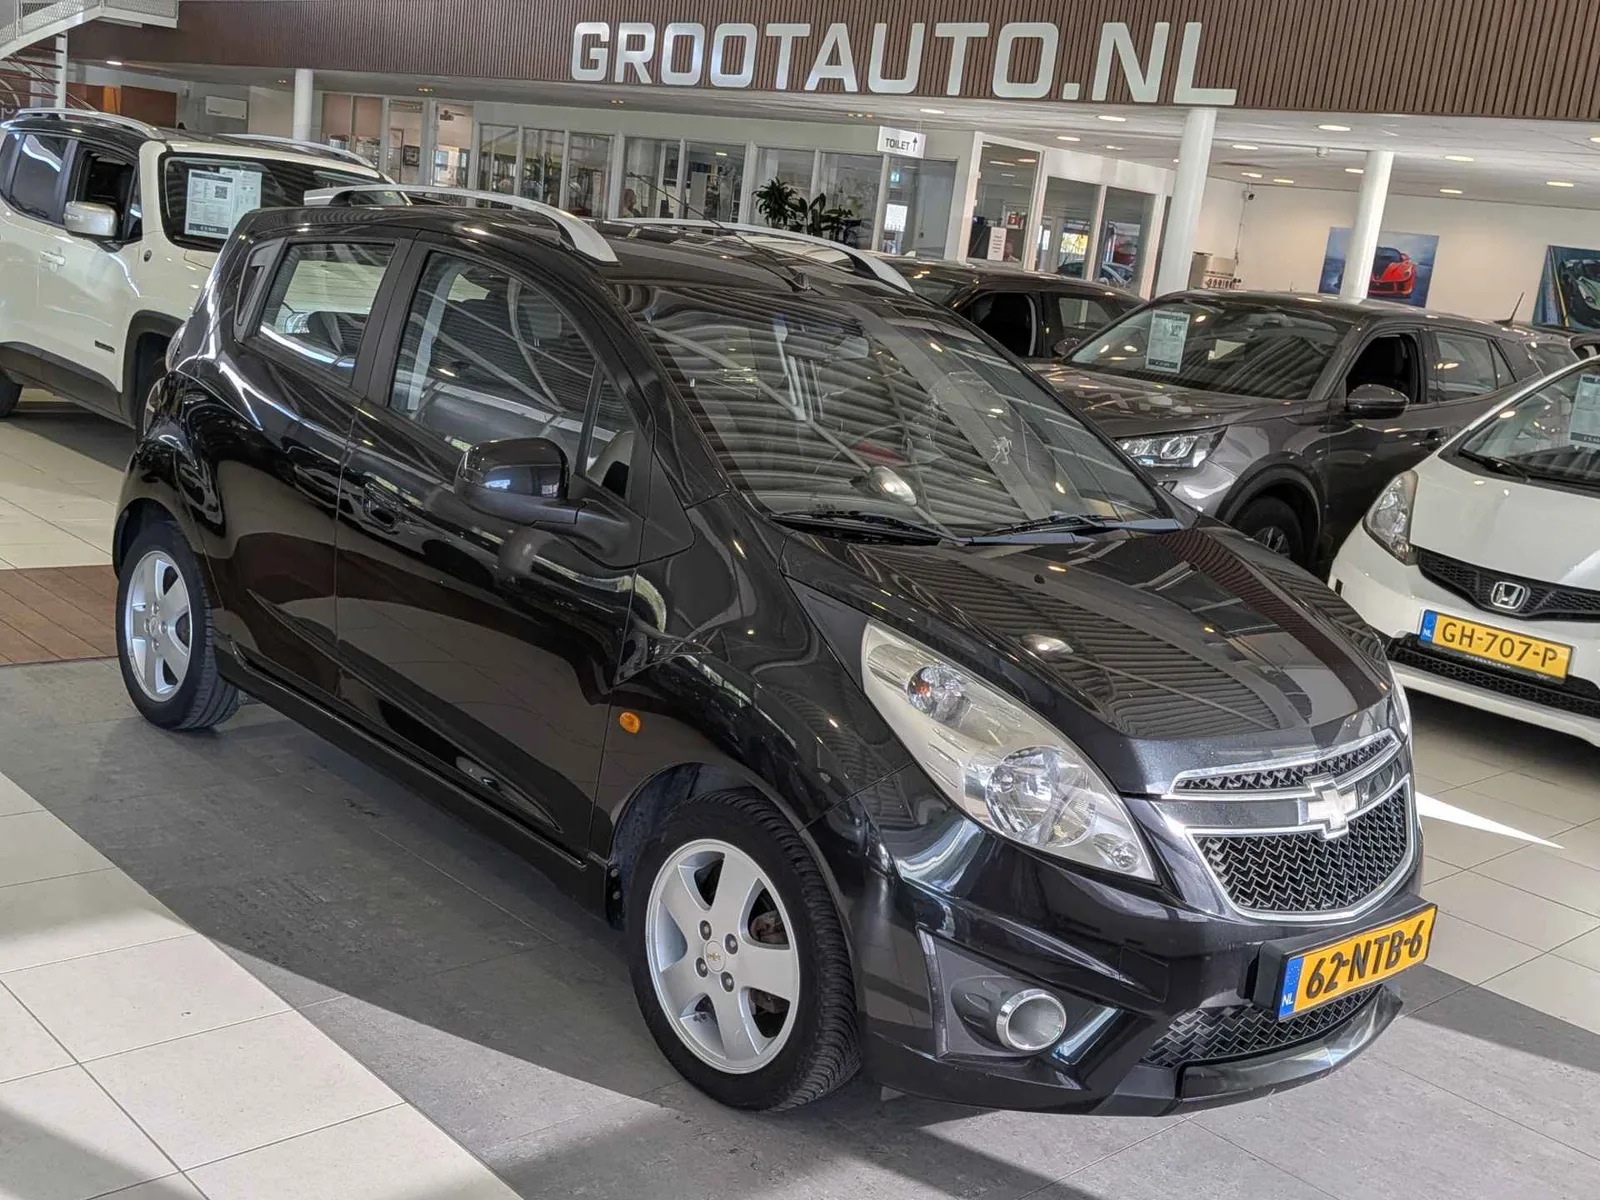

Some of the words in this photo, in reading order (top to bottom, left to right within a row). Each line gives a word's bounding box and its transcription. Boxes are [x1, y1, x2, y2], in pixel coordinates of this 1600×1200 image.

[571, 21, 1237, 107] GROOTAUTO.NL
[885, 138, 911, 150] TOILET
[1423, 629, 1433, 638] NL
[1442, 622, 1558, 668] GH-707-P
[1306, 919, 1424, 1000] 62-NTB-6
[1282, 995, 1294, 1006] NL
